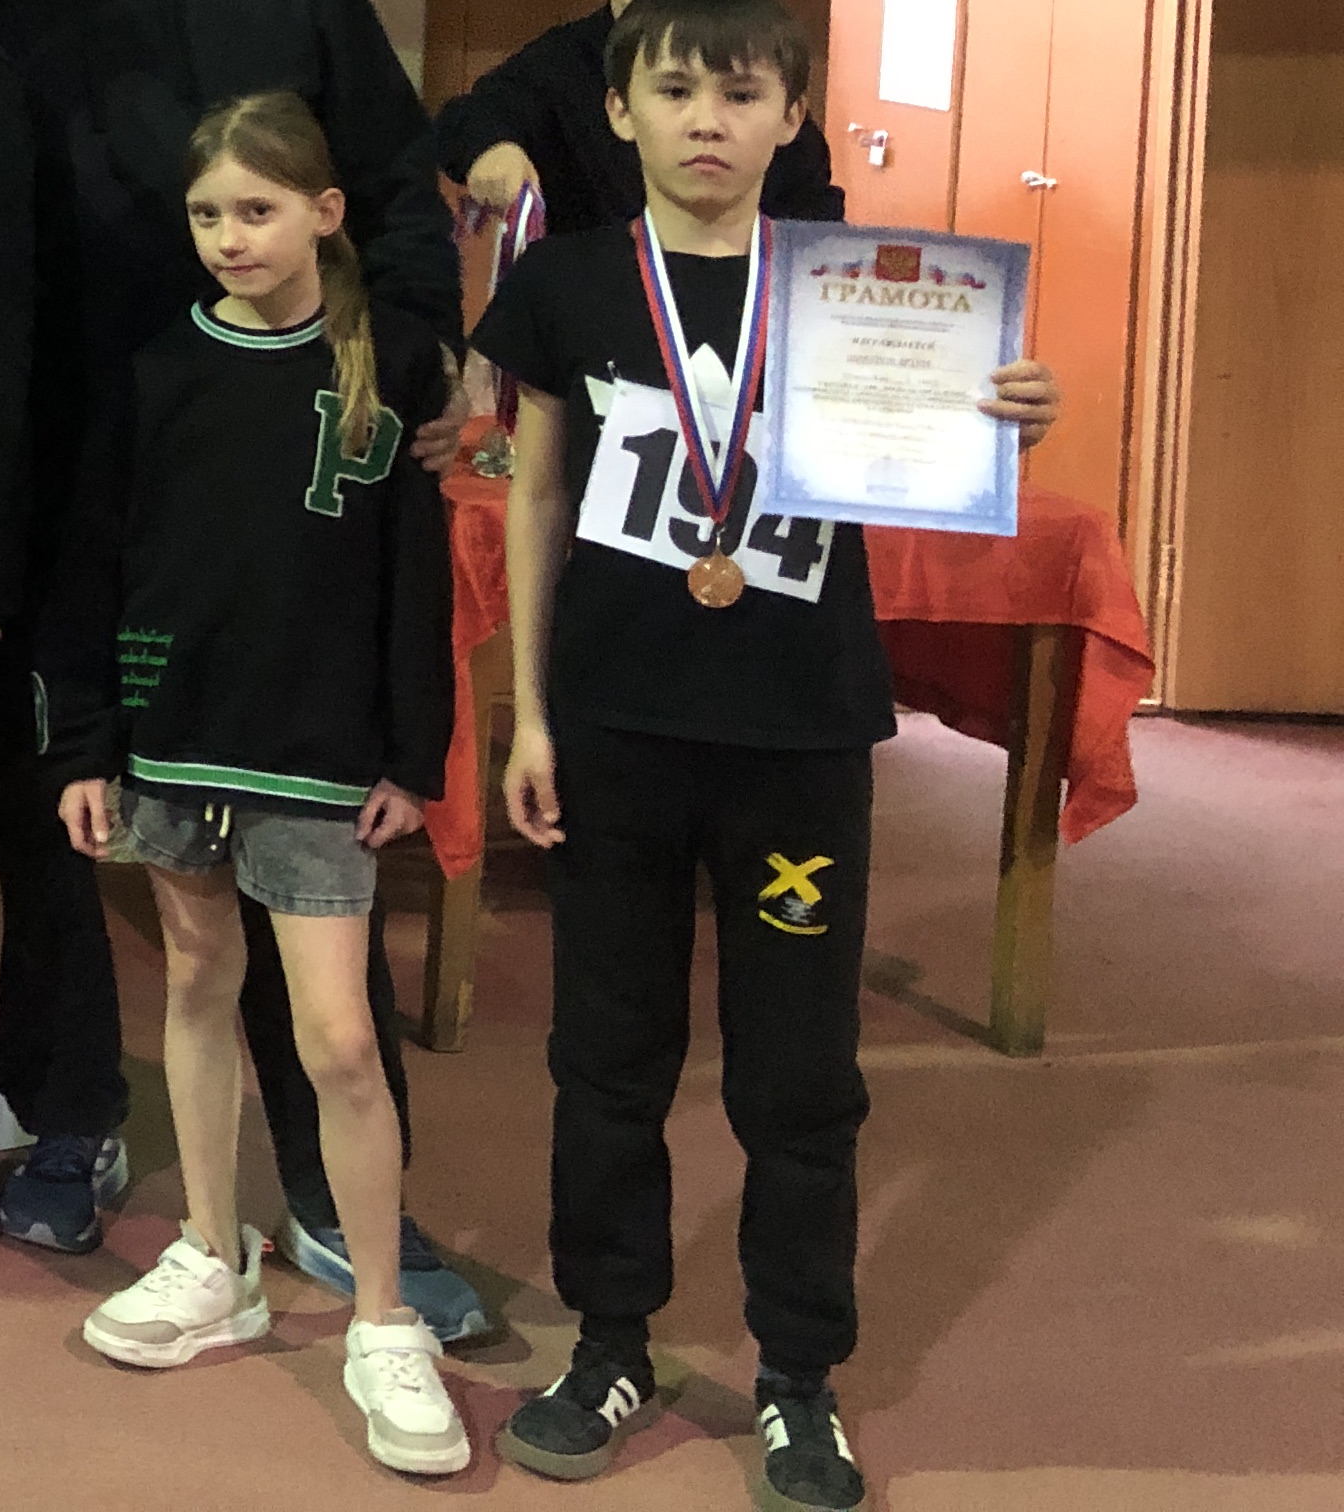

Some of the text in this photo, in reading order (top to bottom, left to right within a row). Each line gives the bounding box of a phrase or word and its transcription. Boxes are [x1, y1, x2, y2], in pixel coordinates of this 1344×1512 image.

[818, 282, 974, 314] ГРАМОТА
[305, 389, 404, 518] P
[620, 426, 825, 583] 194
